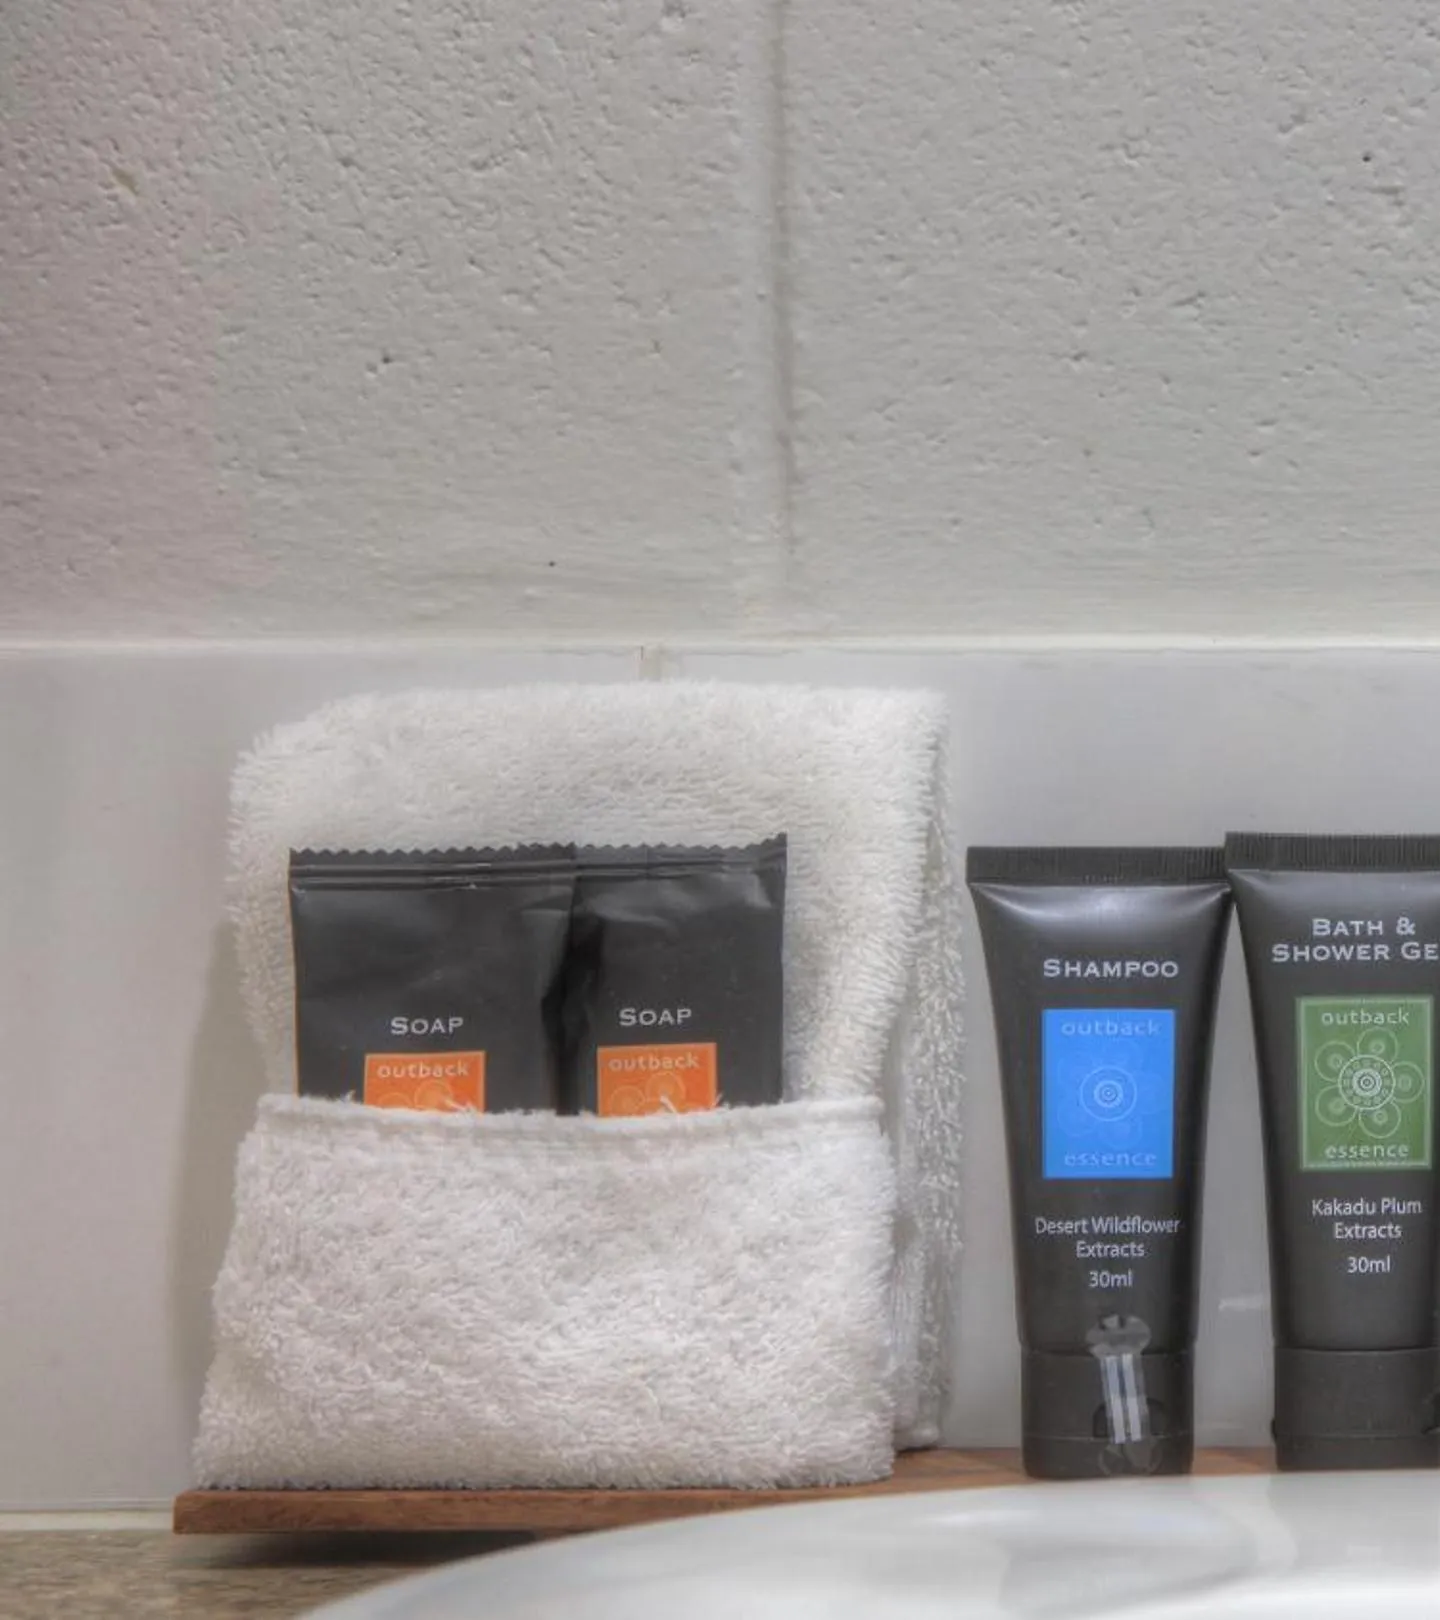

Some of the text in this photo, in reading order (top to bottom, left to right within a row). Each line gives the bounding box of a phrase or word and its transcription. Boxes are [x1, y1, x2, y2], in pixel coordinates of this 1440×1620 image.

[1312, 918, 1416, 936] BATH &
[1272, 944, 1391, 962] SHOWER
[1042, 959, 1179, 978] SHAMPOO
[619, 1007, 692, 1026] SOAP
[1321, 1007, 1409, 1025] outback
[390, 1016, 464, 1035] SOAP
[1061, 1019, 1161, 1036] outback
[377, 1060, 469, 1079] outback
[608, 1052, 698, 1071] outback
[1064, 1151, 1156, 1166] essence
[1325, 1144, 1409, 1159] essence
[1312, 1198, 1422, 1216] Kakadu Plum
[1035, 1216, 1180, 1234] Desert Wildflower
[1334, 1222, 1401, 1239] Extracts
[1076, 1241, 1144, 1258] Extracts
[1347, 1256, 1391, 1274] 30ml
[1089, 1271, 1132, 1287] 30ml
